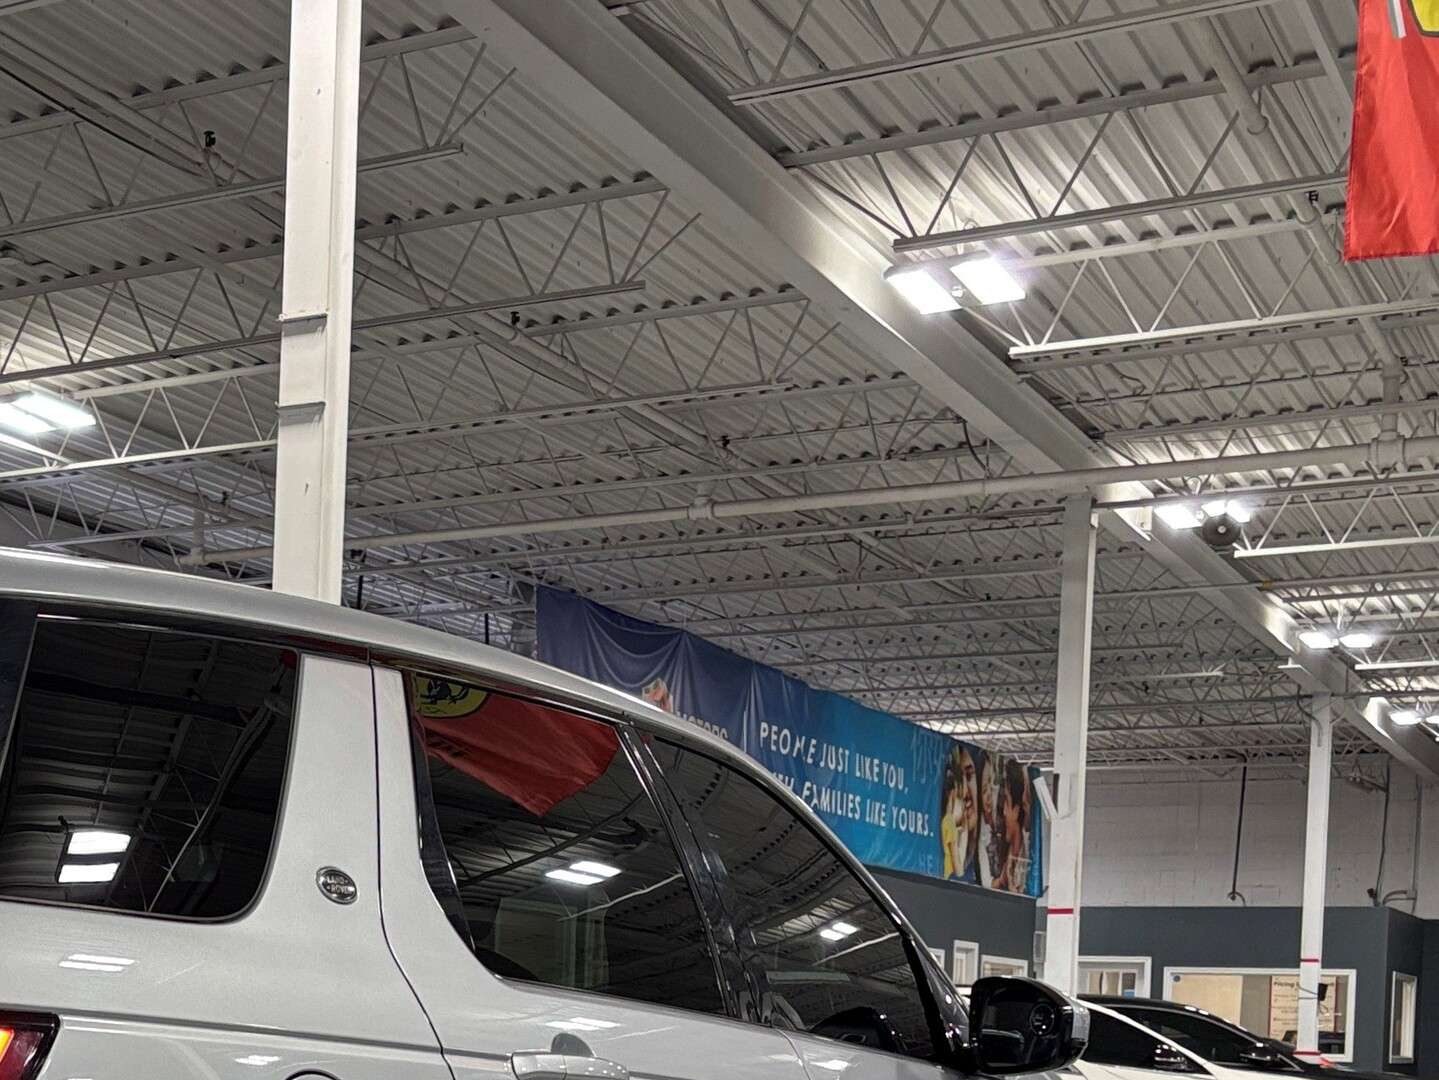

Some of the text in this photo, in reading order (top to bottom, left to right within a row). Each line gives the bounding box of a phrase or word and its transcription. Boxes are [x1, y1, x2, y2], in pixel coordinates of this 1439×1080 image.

[820, 743, 850, 774] JUST
[855, 752, 879, 783] LIKE
[882, 762, 909, 795] YOU,
[802, 780, 862, 820] FAMILIES
[865, 799, 886, 827] LIKE
[892, 805, 935, 837] YOURS.
